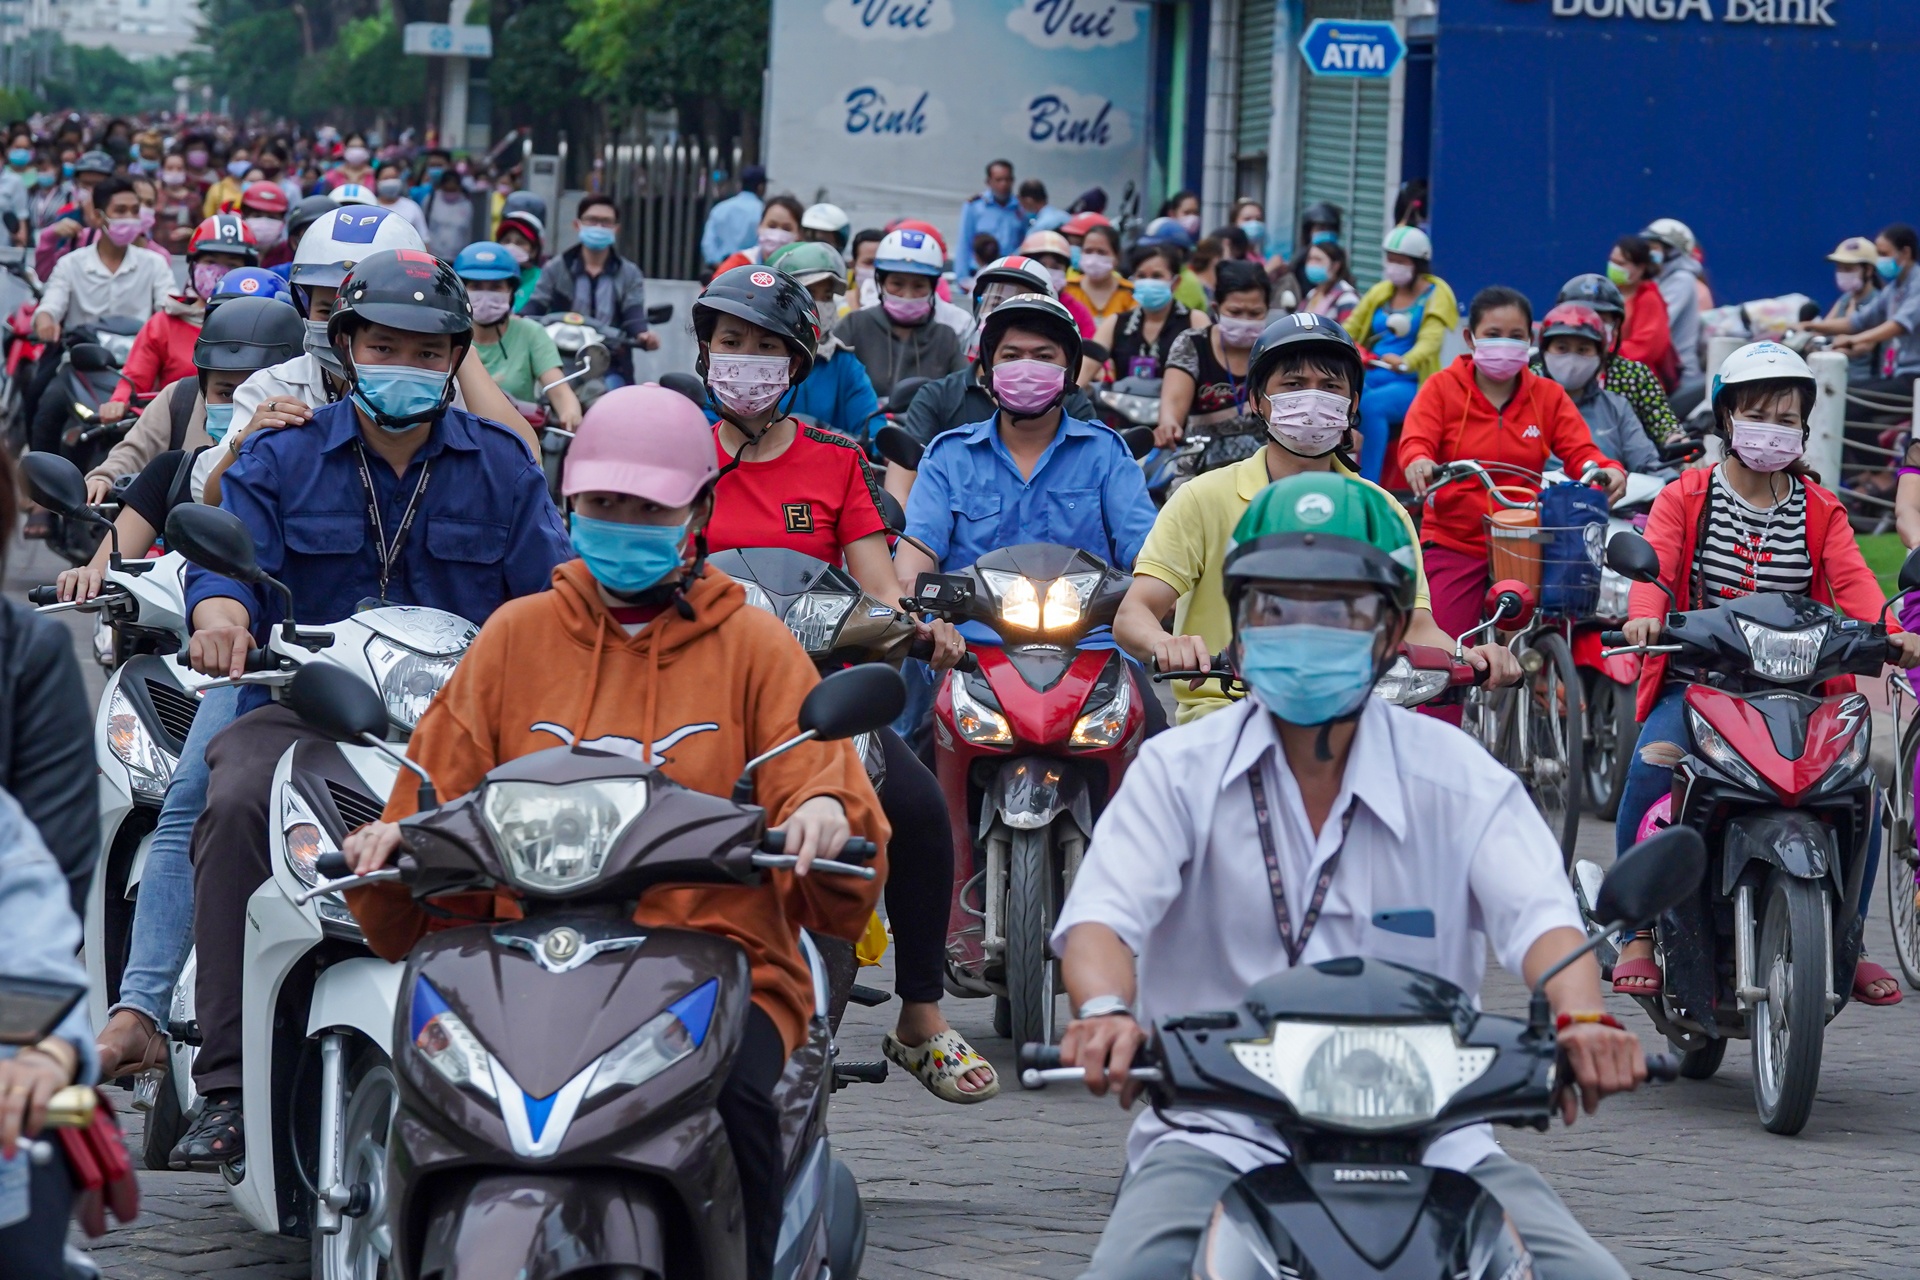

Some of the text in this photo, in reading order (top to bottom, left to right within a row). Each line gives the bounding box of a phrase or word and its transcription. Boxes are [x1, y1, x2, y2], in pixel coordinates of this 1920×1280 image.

[850, 0, 932, 28] Vui
[1033, 0, 1116, 37] Vui
[1724, 0, 1836, 26] Bank
[1321, 42, 1386, 70] ATM
[845, 86, 930, 134] Bình
[1028, 94, 1113, 145] Bình
[359, 467, 369, 488] Supreme
[419, 473, 430, 494] Supreme
[368, 503, 377, 526] Supreme
[404, 509, 416, 530] Supreme
[375, 541, 384, 563] Supreme
[1334, 1169, 1411, 1182] HONDA
